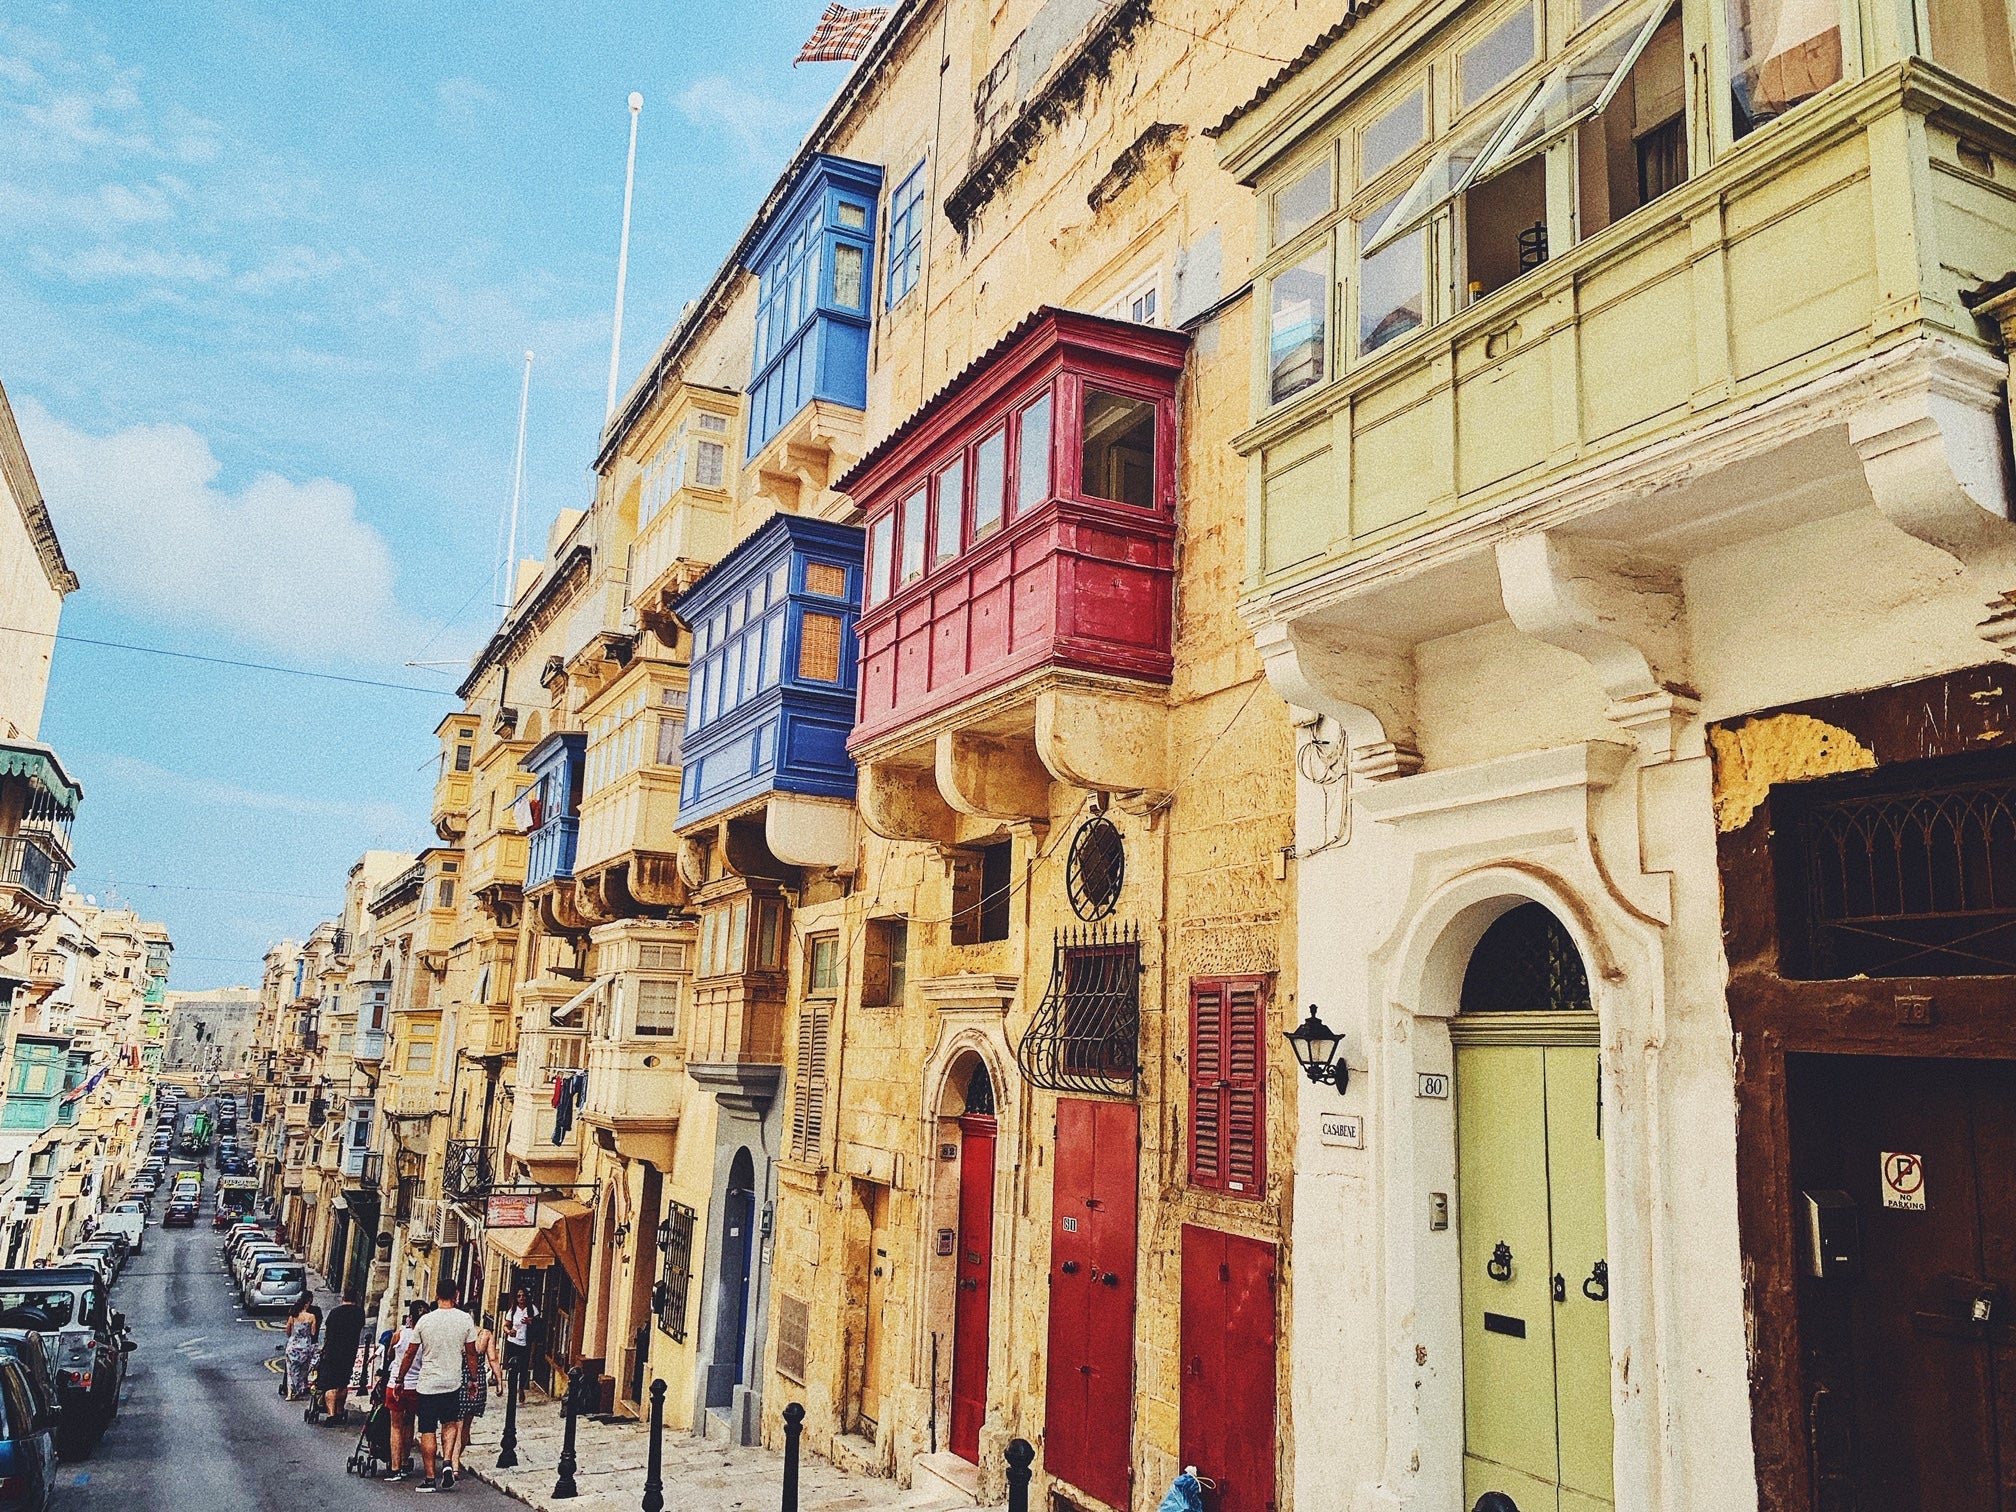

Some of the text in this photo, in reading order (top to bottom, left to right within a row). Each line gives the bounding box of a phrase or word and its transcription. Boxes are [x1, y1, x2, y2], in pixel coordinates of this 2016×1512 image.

[1425, 1077, 1442, 1095] 80
[1322, 1123, 1356, 1138] CASABENE
[1896, 1158, 1913, 1186] P
[1888, 1200, 1925, 1210] PARKING
